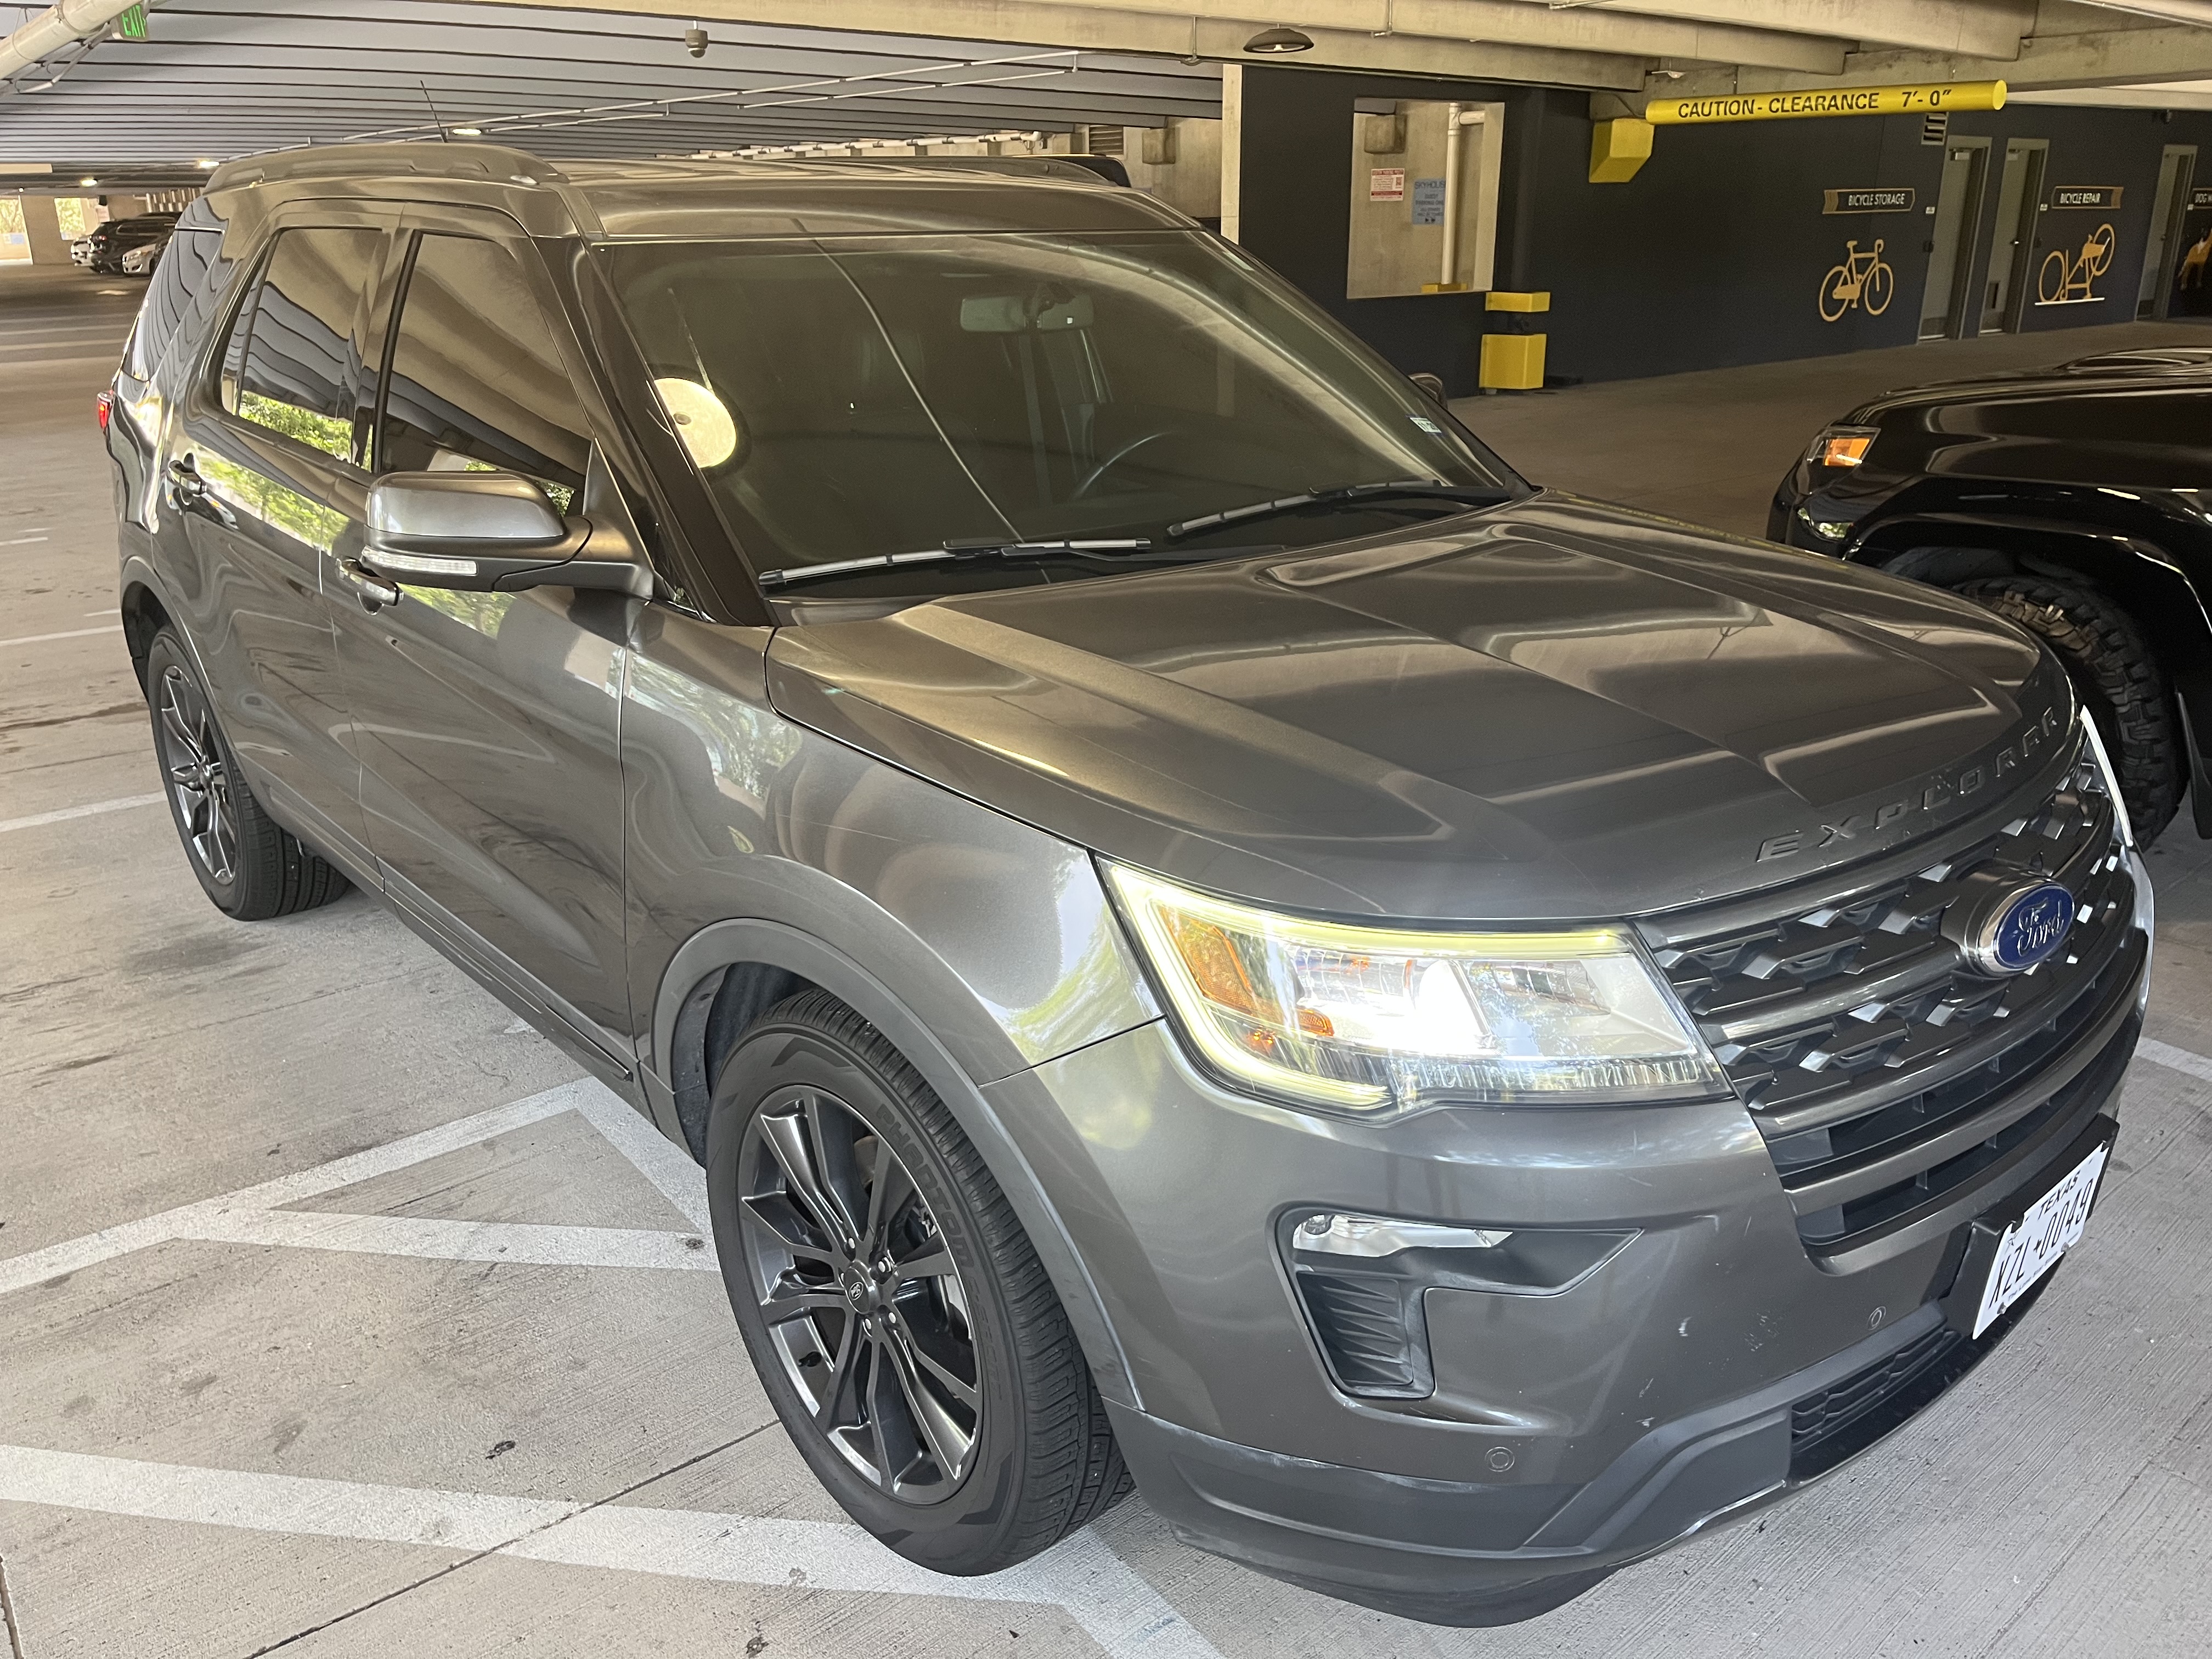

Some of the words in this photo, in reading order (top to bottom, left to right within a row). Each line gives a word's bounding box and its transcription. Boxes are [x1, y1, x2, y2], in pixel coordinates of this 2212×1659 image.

[1768, 92, 1880, 114] CLEARANCE
[1848, 194, 1874, 206] BICYCLE
[1874, 193, 1905, 205] STORAGE
[2059, 193, 2082, 204] BICYCLE
[2082, 193, 2101, 204] REPAIR
[1757, 706, 2058, 862] EXPLORER
[2013, 896, 2064, 957] Ford
[876, 1103, 975, 1269] PHANTOM
[2038, 1170, 2081, 1221] TEXAS
